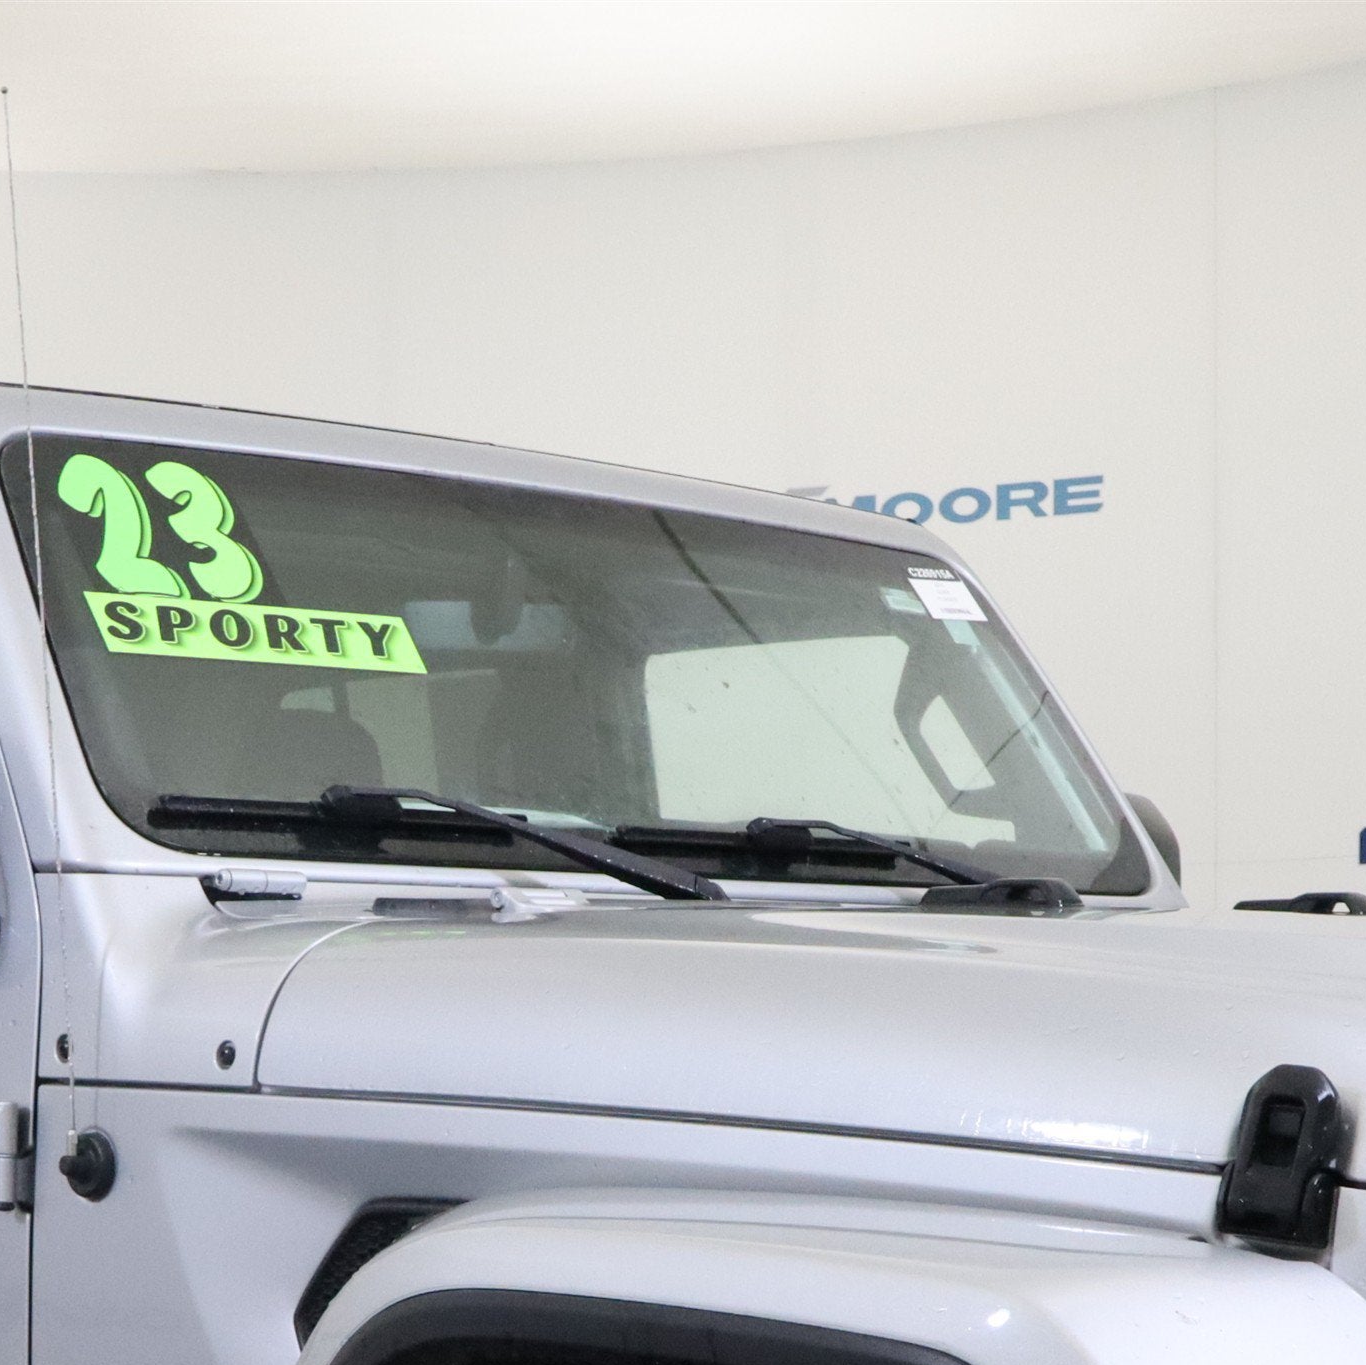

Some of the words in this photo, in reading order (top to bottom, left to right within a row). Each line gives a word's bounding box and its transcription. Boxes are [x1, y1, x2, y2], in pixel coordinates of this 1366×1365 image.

[58, 454, 264, 603] 23
[825, 475, 1104, 525] OORE
[104, 601, 392, 658] SPORTY
